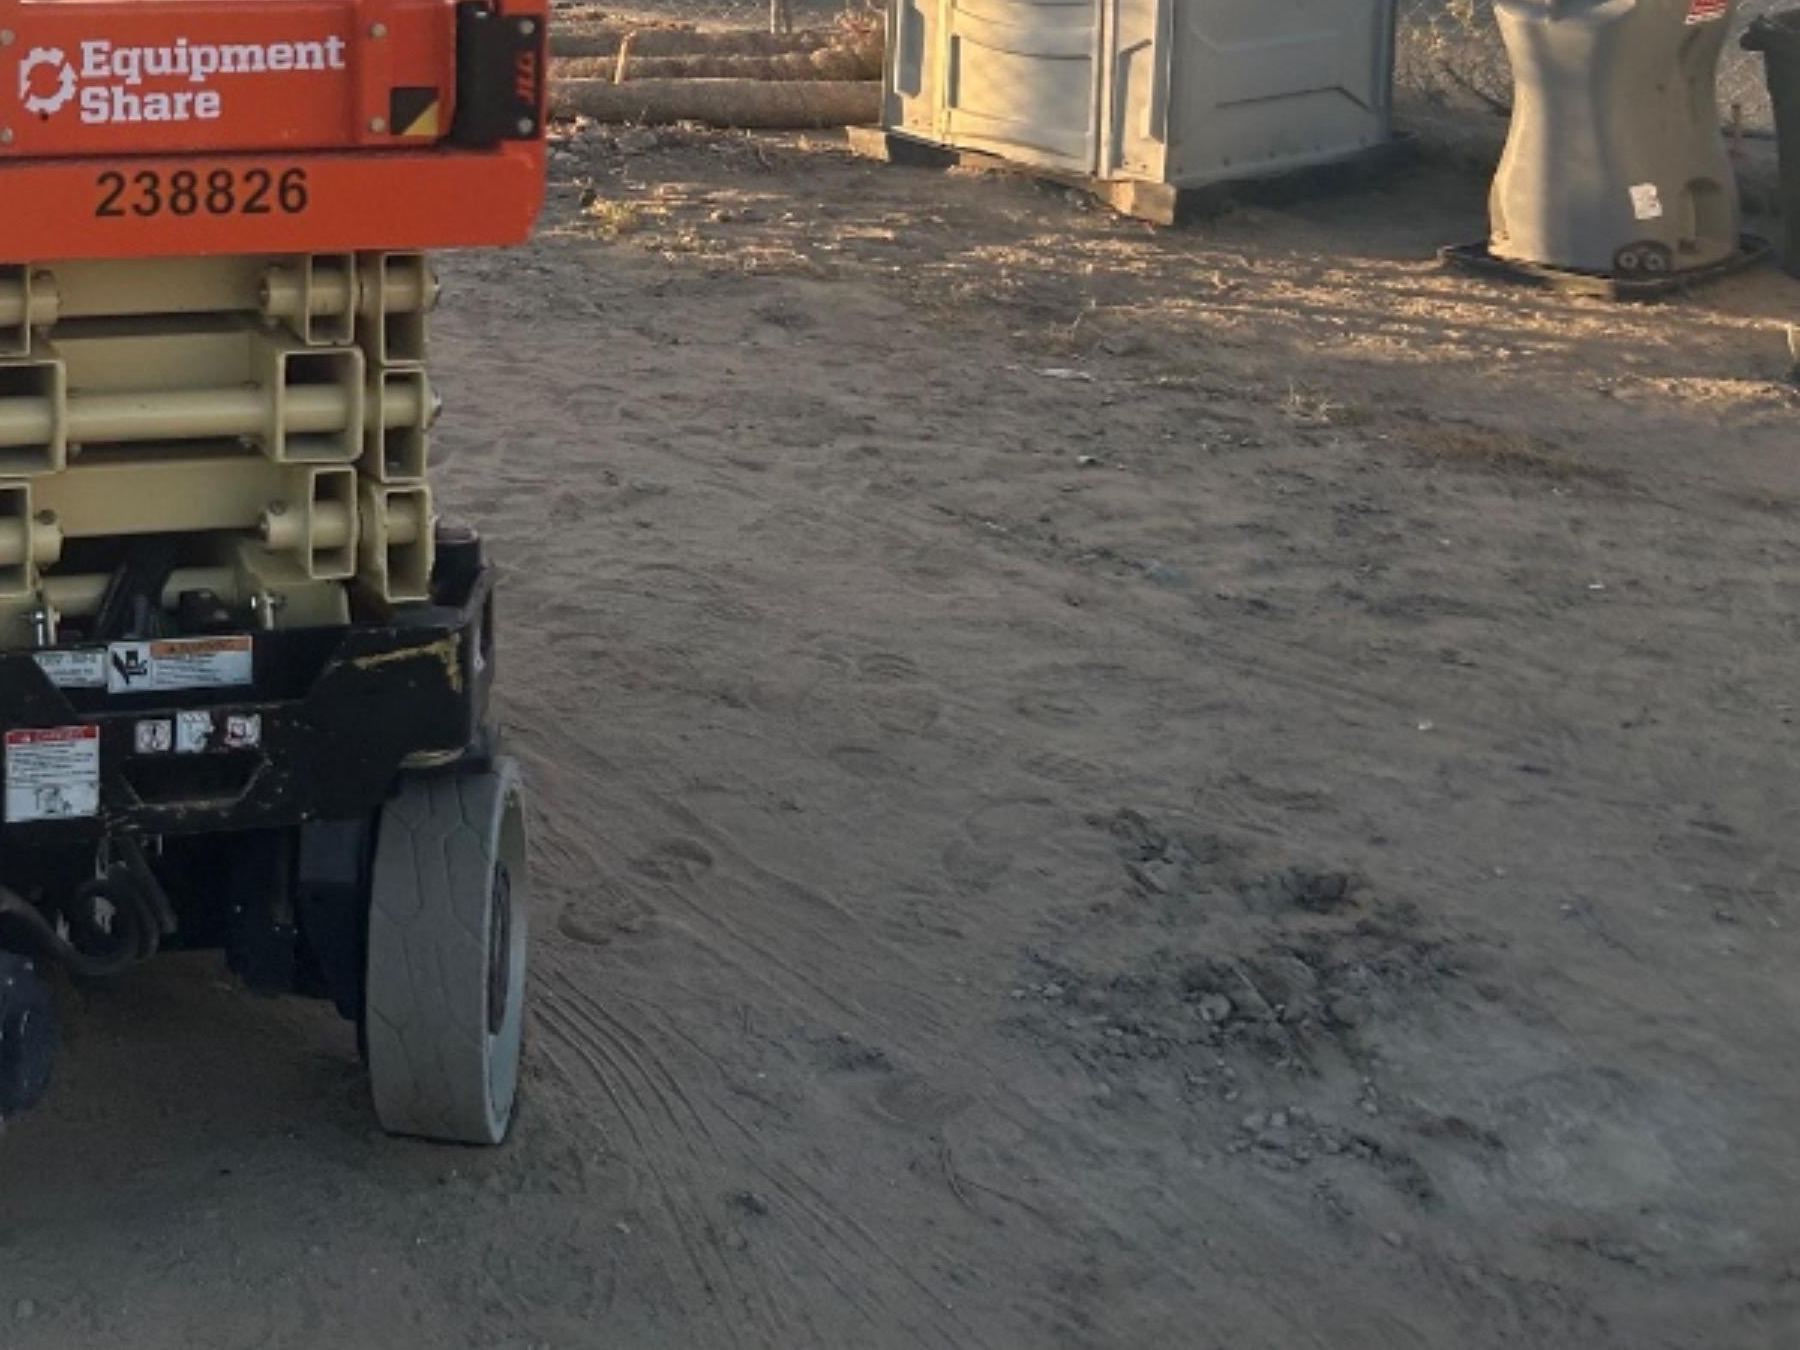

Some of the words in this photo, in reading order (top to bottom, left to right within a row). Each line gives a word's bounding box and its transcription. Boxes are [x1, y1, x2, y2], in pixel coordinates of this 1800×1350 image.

[80, 36, 346, 84] Equipment
[80, 84, 221, 125] Share
[95, 167, 308, 217] 238826
